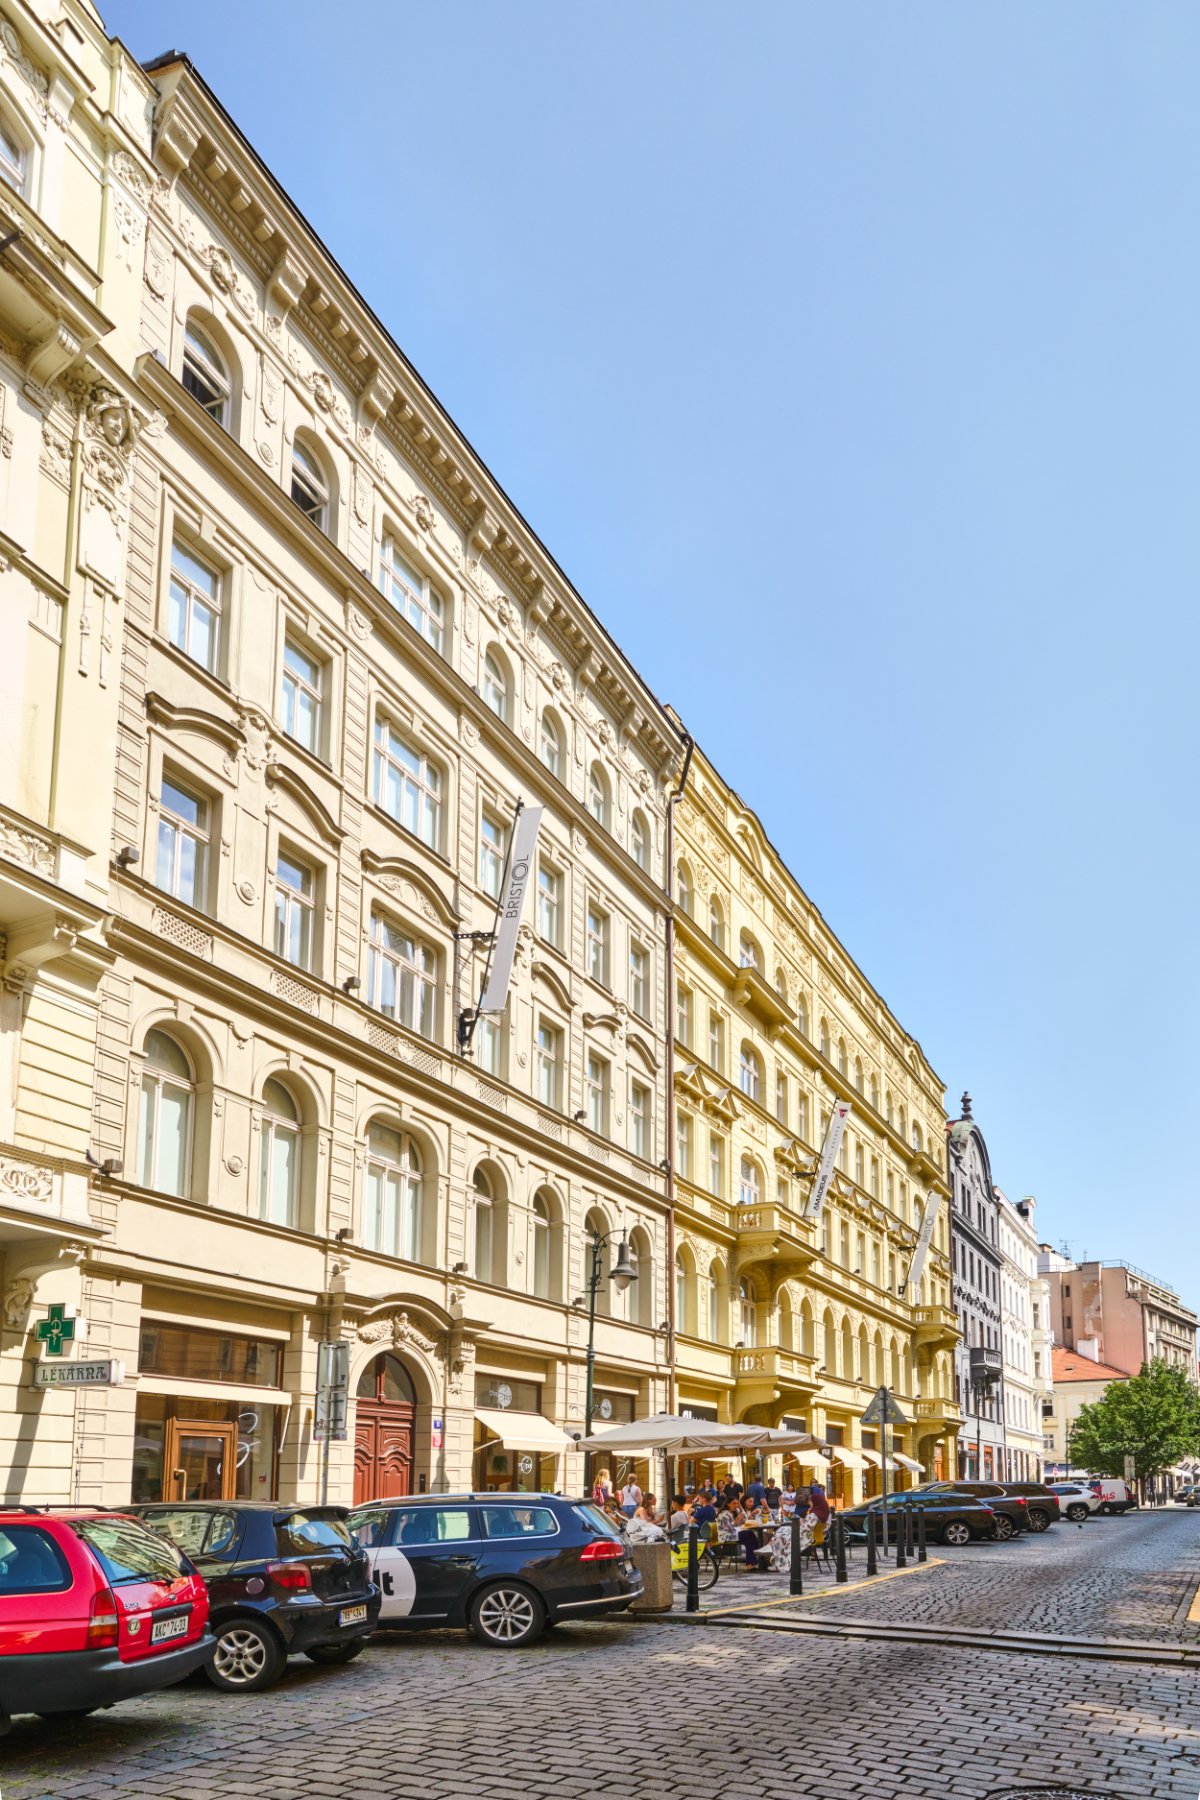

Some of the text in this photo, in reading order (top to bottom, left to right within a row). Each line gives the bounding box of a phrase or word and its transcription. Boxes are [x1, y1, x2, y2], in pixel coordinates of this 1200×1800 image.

[506, 853, 530, 919] BRISTOL
[41, 1365, 107, 1382] LÉKÁRNA
[155, 1623, 167, 1638] AKC
